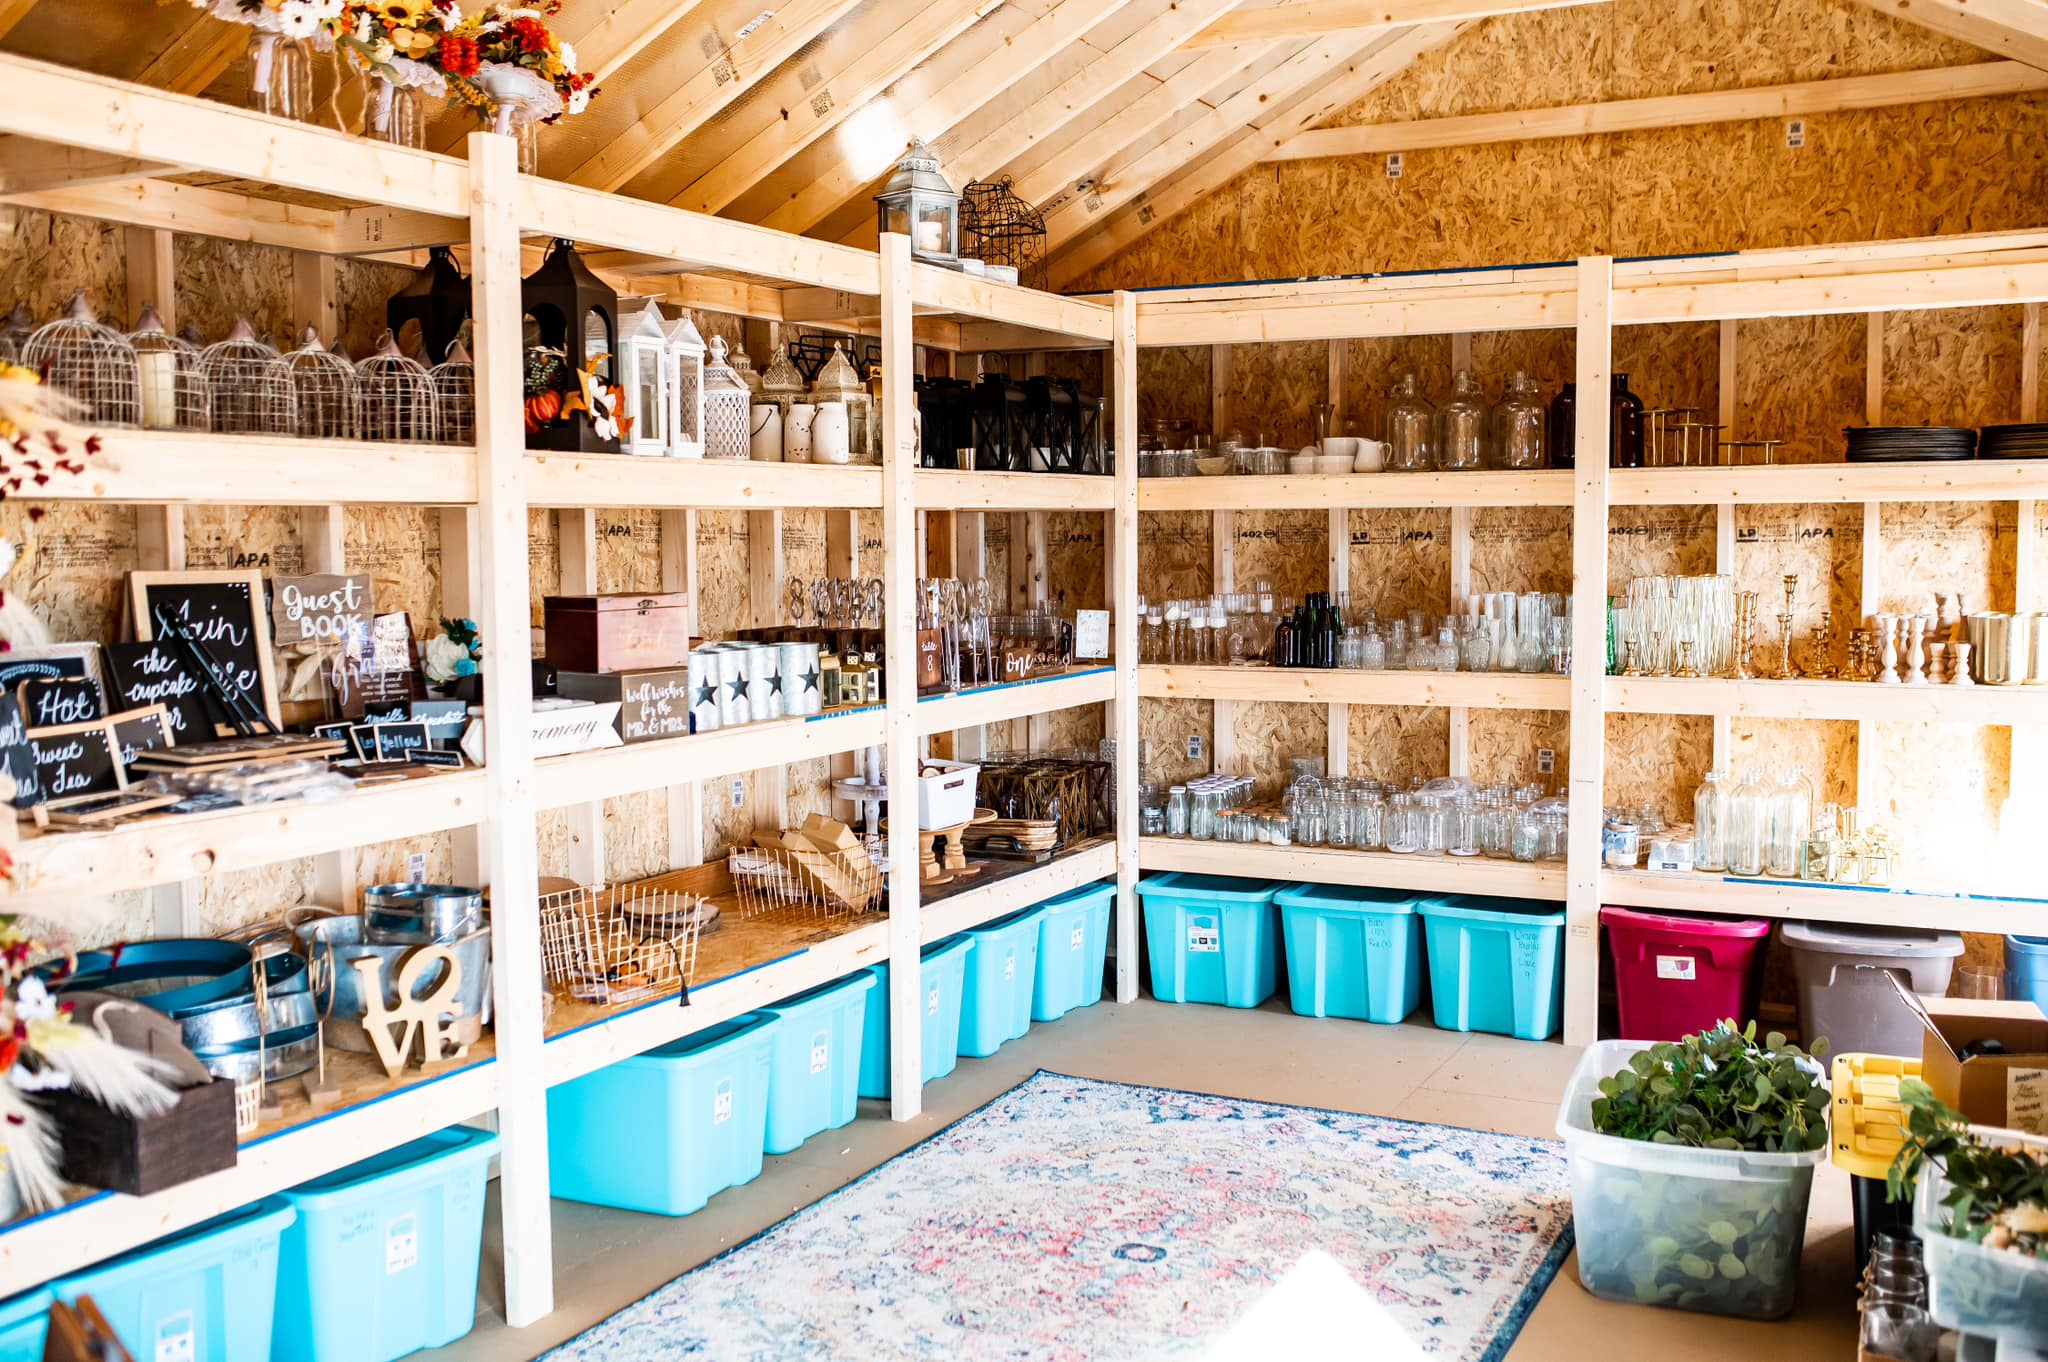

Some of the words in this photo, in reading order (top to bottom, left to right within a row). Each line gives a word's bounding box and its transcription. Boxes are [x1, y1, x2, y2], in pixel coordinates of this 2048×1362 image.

[607, 525, 631, 537] APA
[1068, 533, 1093, 543] APA
[1241, 530, 1263, 538] 402
[1405, 530, 1433, 541] APA
[1800, 527, 1835, 539] APA
[866, 538, 883, 550] APA
[234, 552, 270, 568] APA
[133, 647, 178, 675] the
[926, 653, 933, 672] 8
[1006, 652, 1034, 678] one
[125, 671, 198, 705] cupcake
[37, 687, 94, 726] Hot
[641, 700, 657, 722] for
[657, 698, 673, 716] the
[532, 719, 598, 745] remony
[648, 717, 659, 735] &
[32, 738, 84, 766] Sweet
[379, 734, 422, 752] Yellow
[52, 762, 91, 794] Tea
